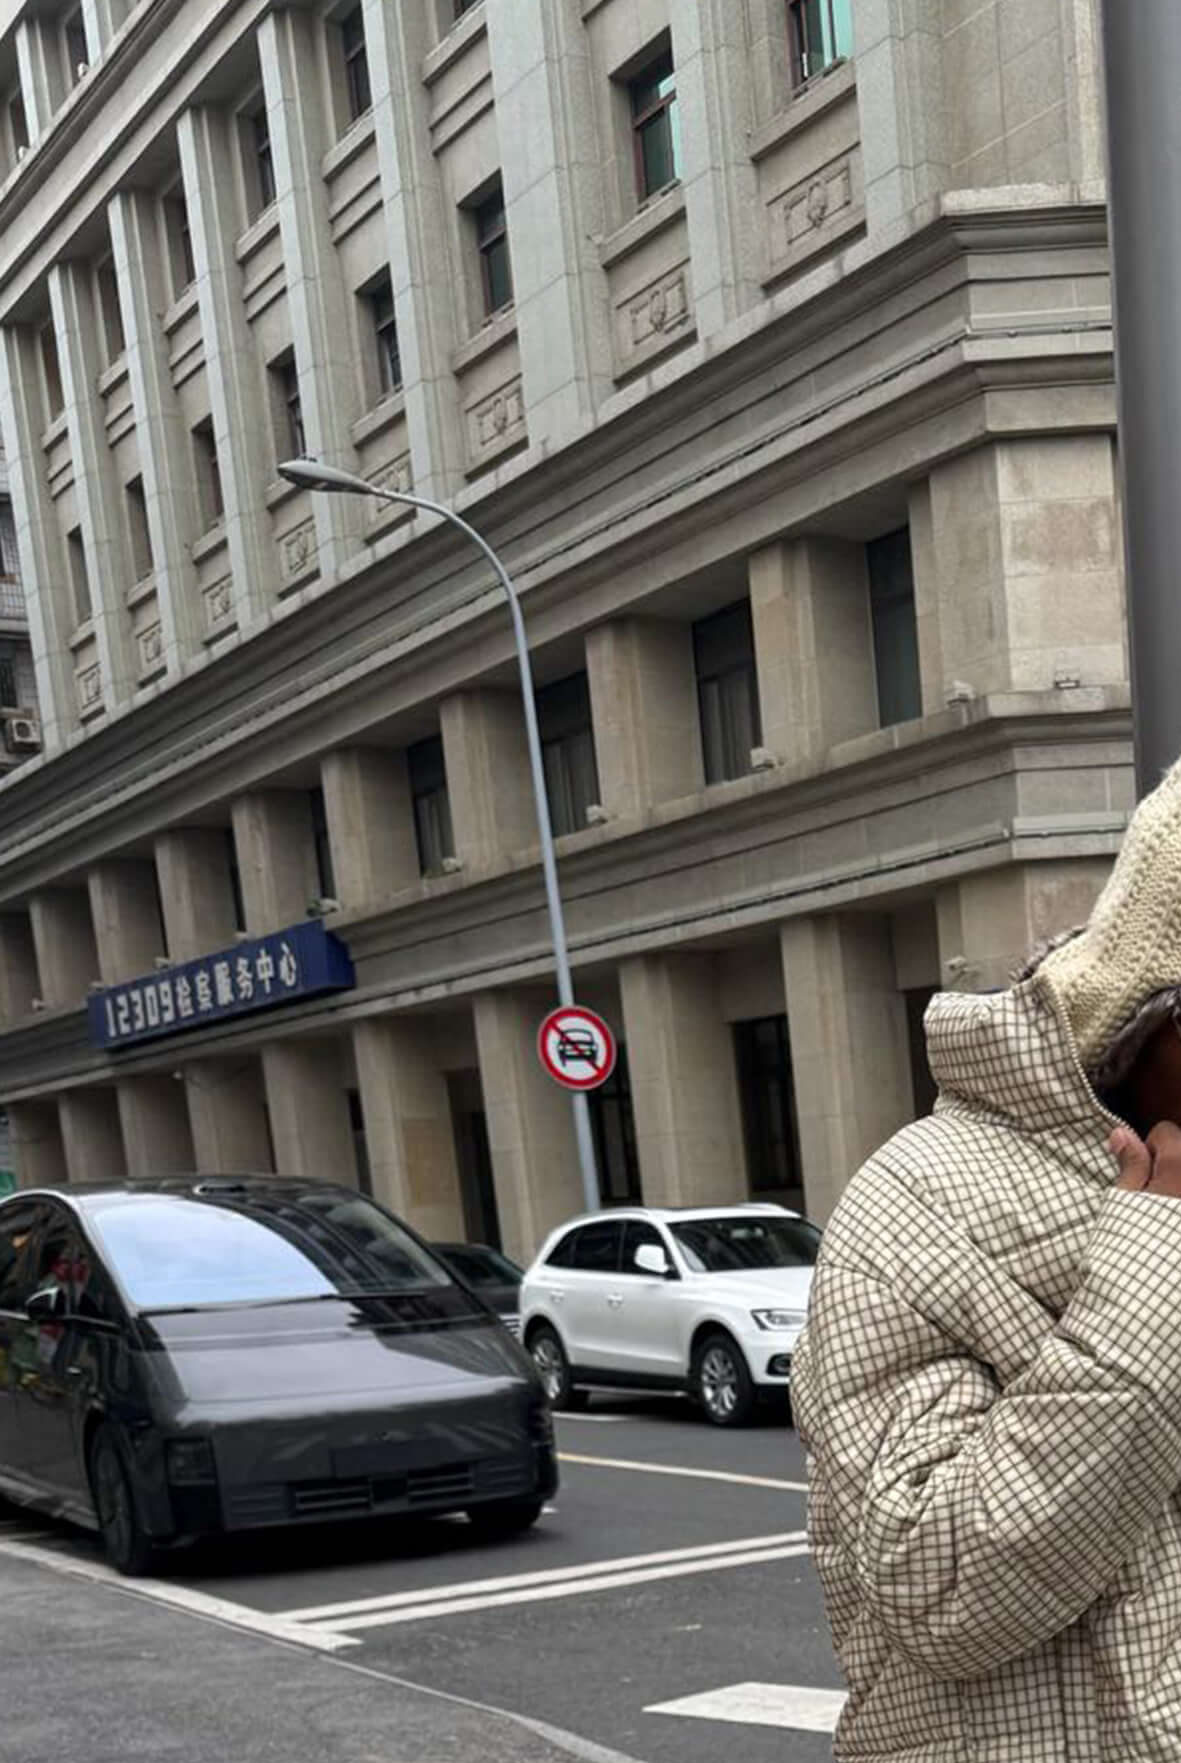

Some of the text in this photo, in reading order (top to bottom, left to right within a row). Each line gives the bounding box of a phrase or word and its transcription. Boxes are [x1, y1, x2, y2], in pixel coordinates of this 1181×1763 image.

[105, 943, 297, 1037] 12309检察服务中心
